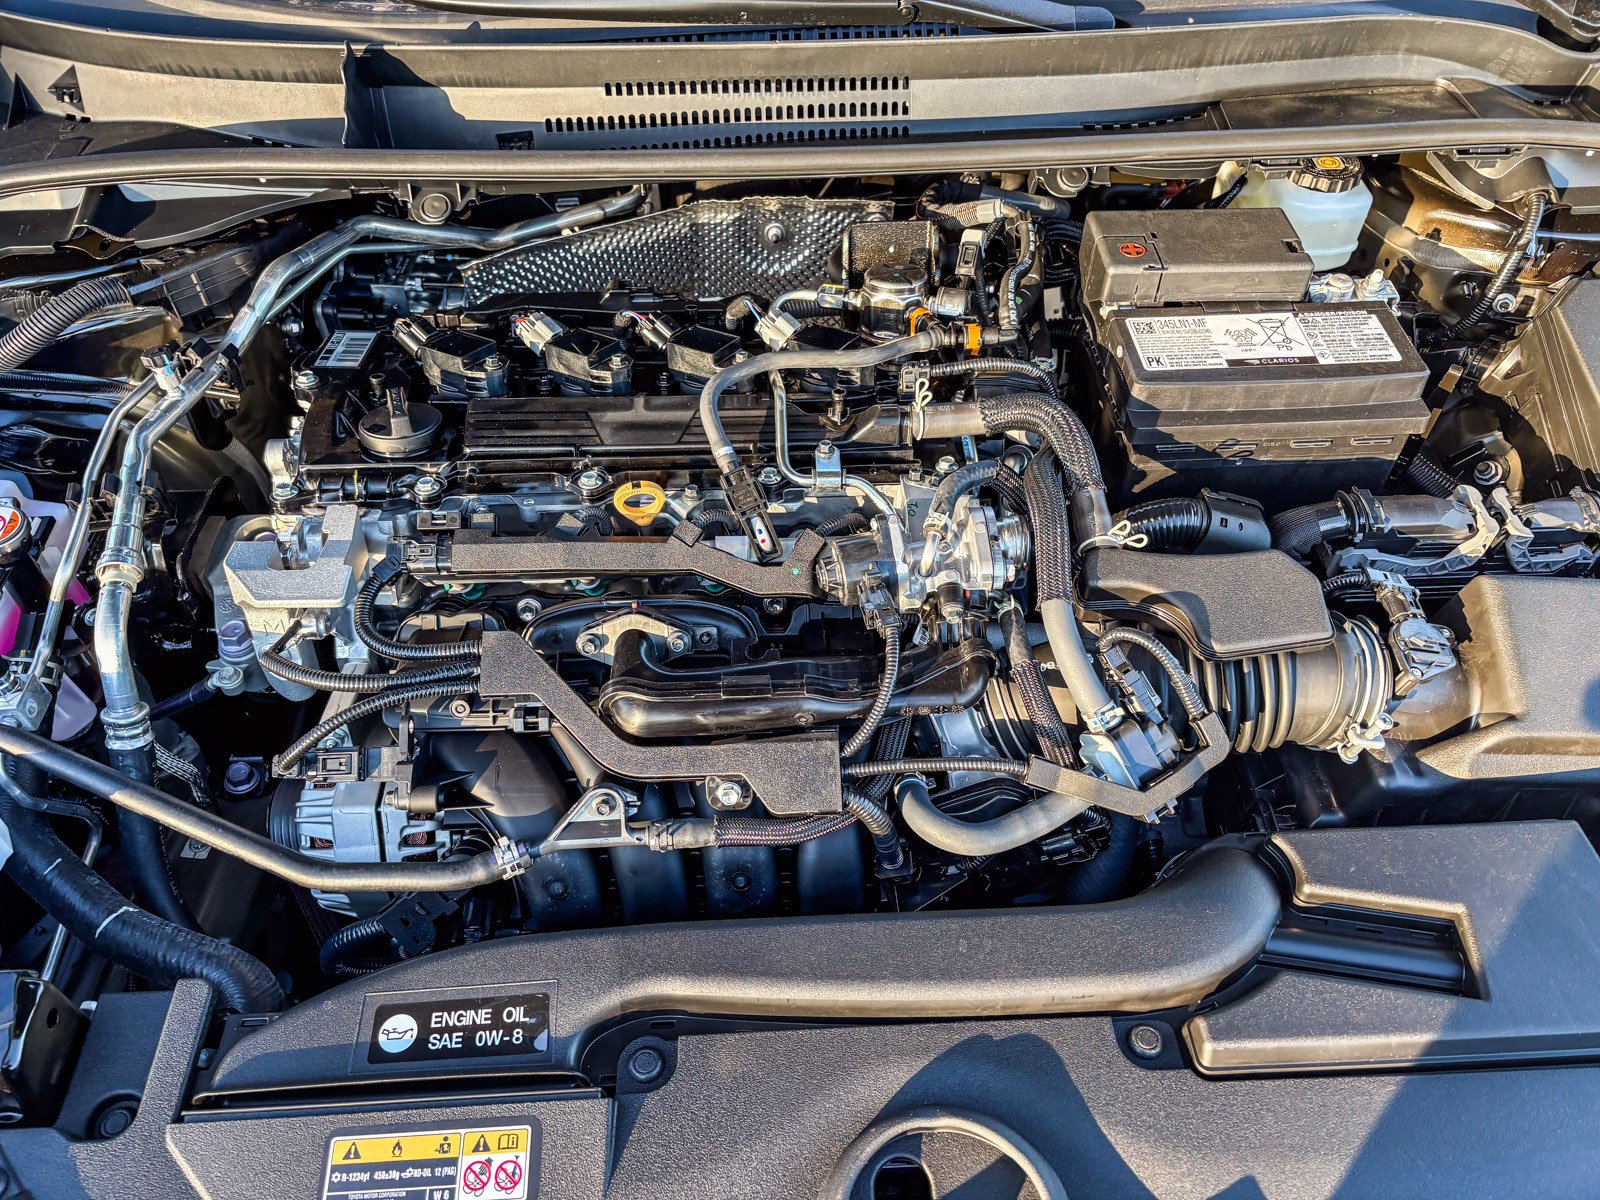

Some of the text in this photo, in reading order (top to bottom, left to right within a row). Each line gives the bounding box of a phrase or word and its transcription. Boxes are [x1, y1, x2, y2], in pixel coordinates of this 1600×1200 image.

[1146, 356, 1165, 367] PK
[431, 1006, 530, 1028] ENGINE OIL
[428, 1029, 523, 1050] SAE 0W-8
[434, 1167, 441, 1176] 12
[378, 1191, 407, 1199] CORPORATION
[433, 1190, 450, 1200] W 6
